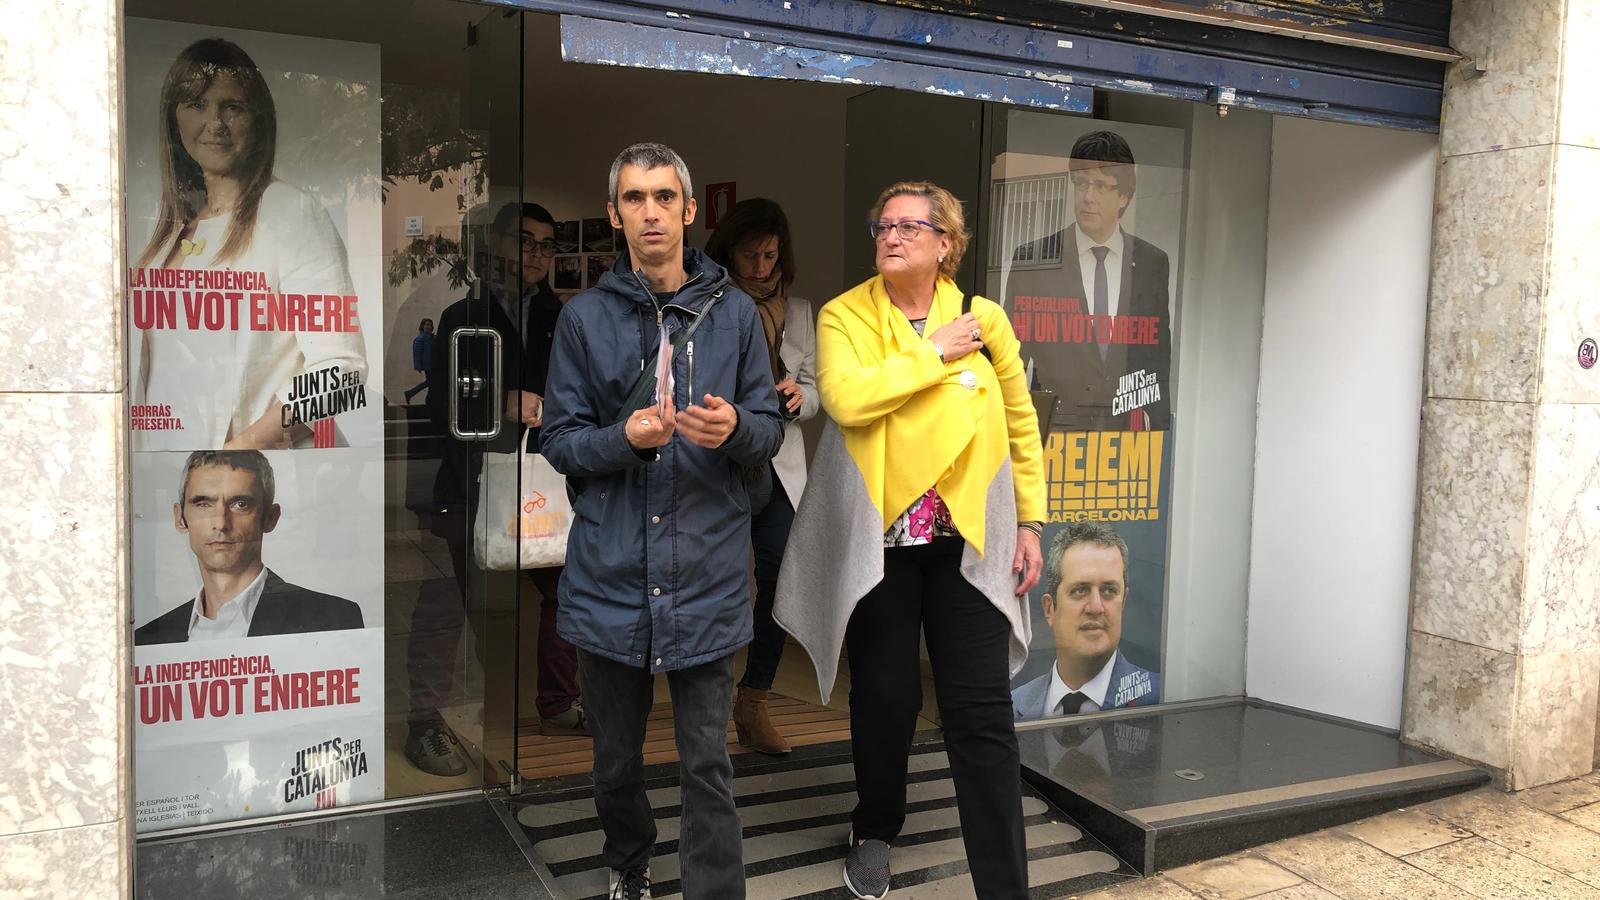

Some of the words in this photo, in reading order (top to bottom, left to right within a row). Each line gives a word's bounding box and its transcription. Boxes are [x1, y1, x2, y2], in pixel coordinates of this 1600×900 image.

[129, 268, 147, 288] LA
[149, 268, 271, 293] INDEPENDÈNCIA,
[133, 290, 177, 330] UN
[182, 292, 243, 331] VOT
[250, 294, 359, 332] ENRERE
[1034, 313, 1058, 343] UN
[1061, 313, 1093, 343] VOT
[1096, 314, 1160, 345] ENRERE
[288, 366, 340, 401] JUNTS
[342, 371, 360, 387] PER
[1116, 369, 1145, 395] JUNTS
[1146, 373, 1157, 384] PER
[131, 404, 171, 417] BORRÀS
[281, 384, 367, 428] CATALUNYA
[1112, 383, 1161, 416] CATALUNYA
[131, 418, 184, 430] PRESENTA.
[135, 664, 153, 685] LA
[156, 654, 275, 677] INDEPENDÈNCIA,
[1118, 670, 1141, 693] JUNTS
[140, 683, 182, 725] UN
[188, 677, 248, 720] VOT
[254, 667, 361, 713] ENRERE
[1114, 679, 1152, 707] CATALUNYA
[291, 737, 342, 777] JUNTS
[343, 738, 361, 755] PER
[284, 752, 368, 804] CATALUNYA
